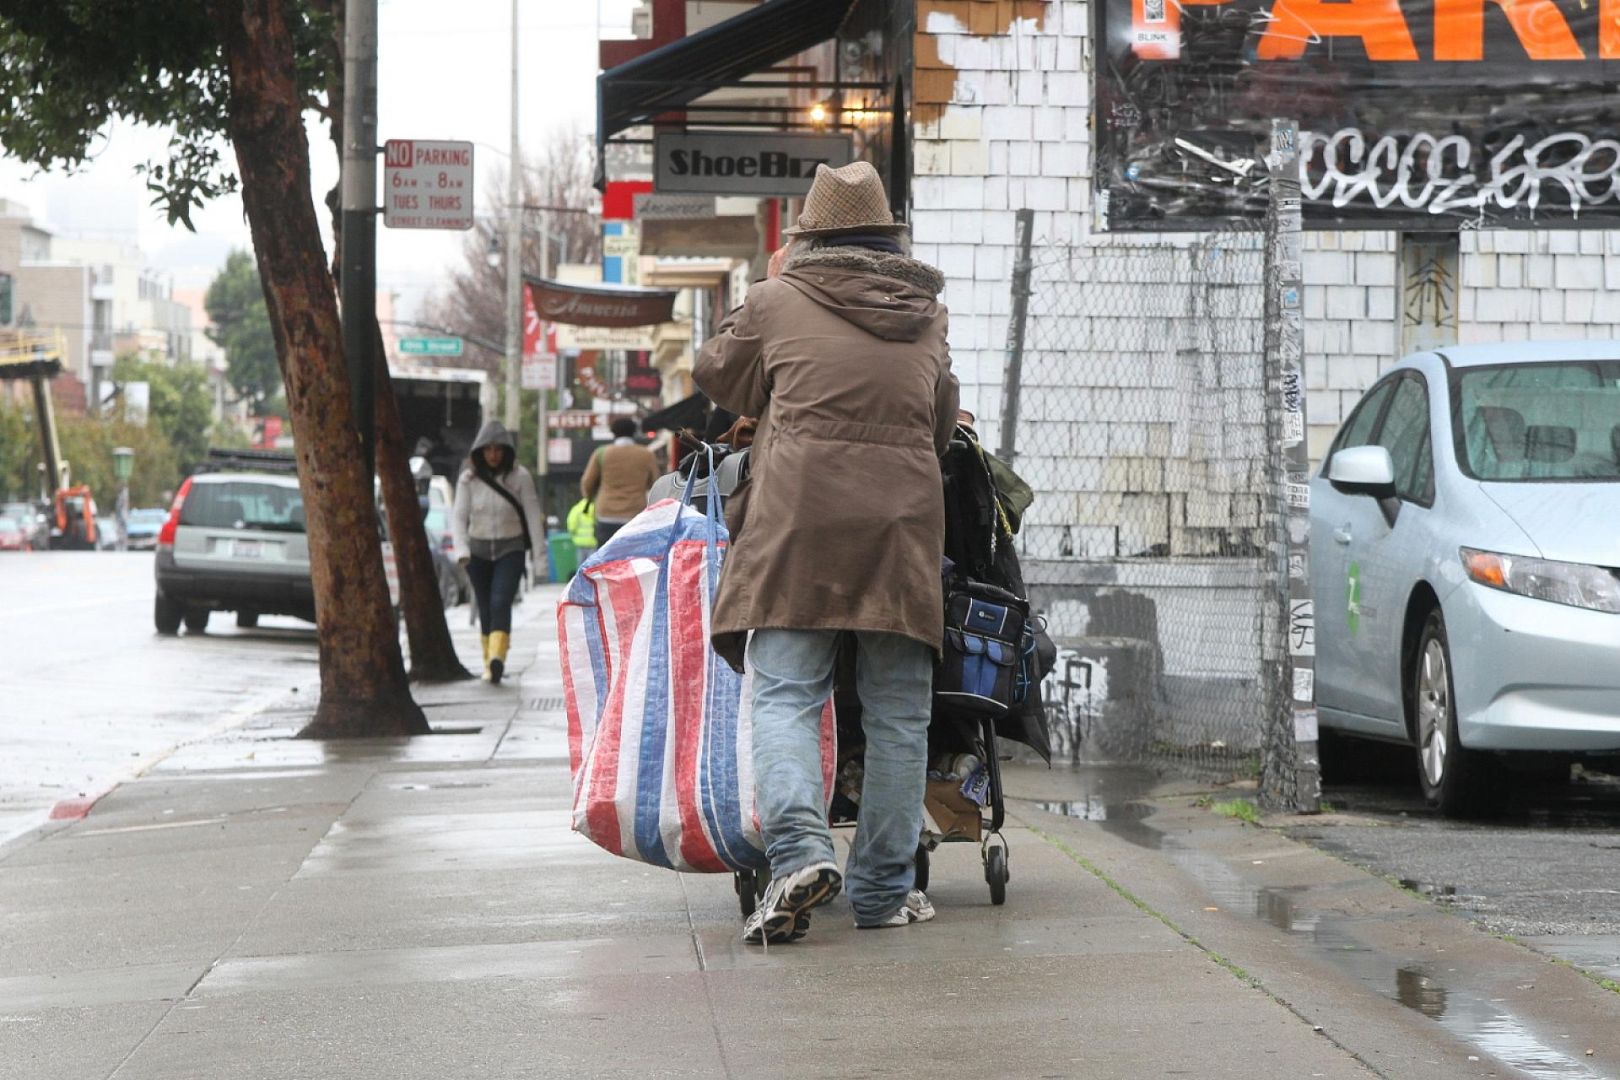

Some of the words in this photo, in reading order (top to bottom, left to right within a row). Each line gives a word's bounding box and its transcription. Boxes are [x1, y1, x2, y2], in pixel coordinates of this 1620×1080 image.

[1137, 34, 1168, 42] BLINK
[387, 142, 411, 166] NO
[416, 147, 470, 166] PARKING
[393, 195, 418, 209] TUES
[429, 195, 462, 210] THURS
